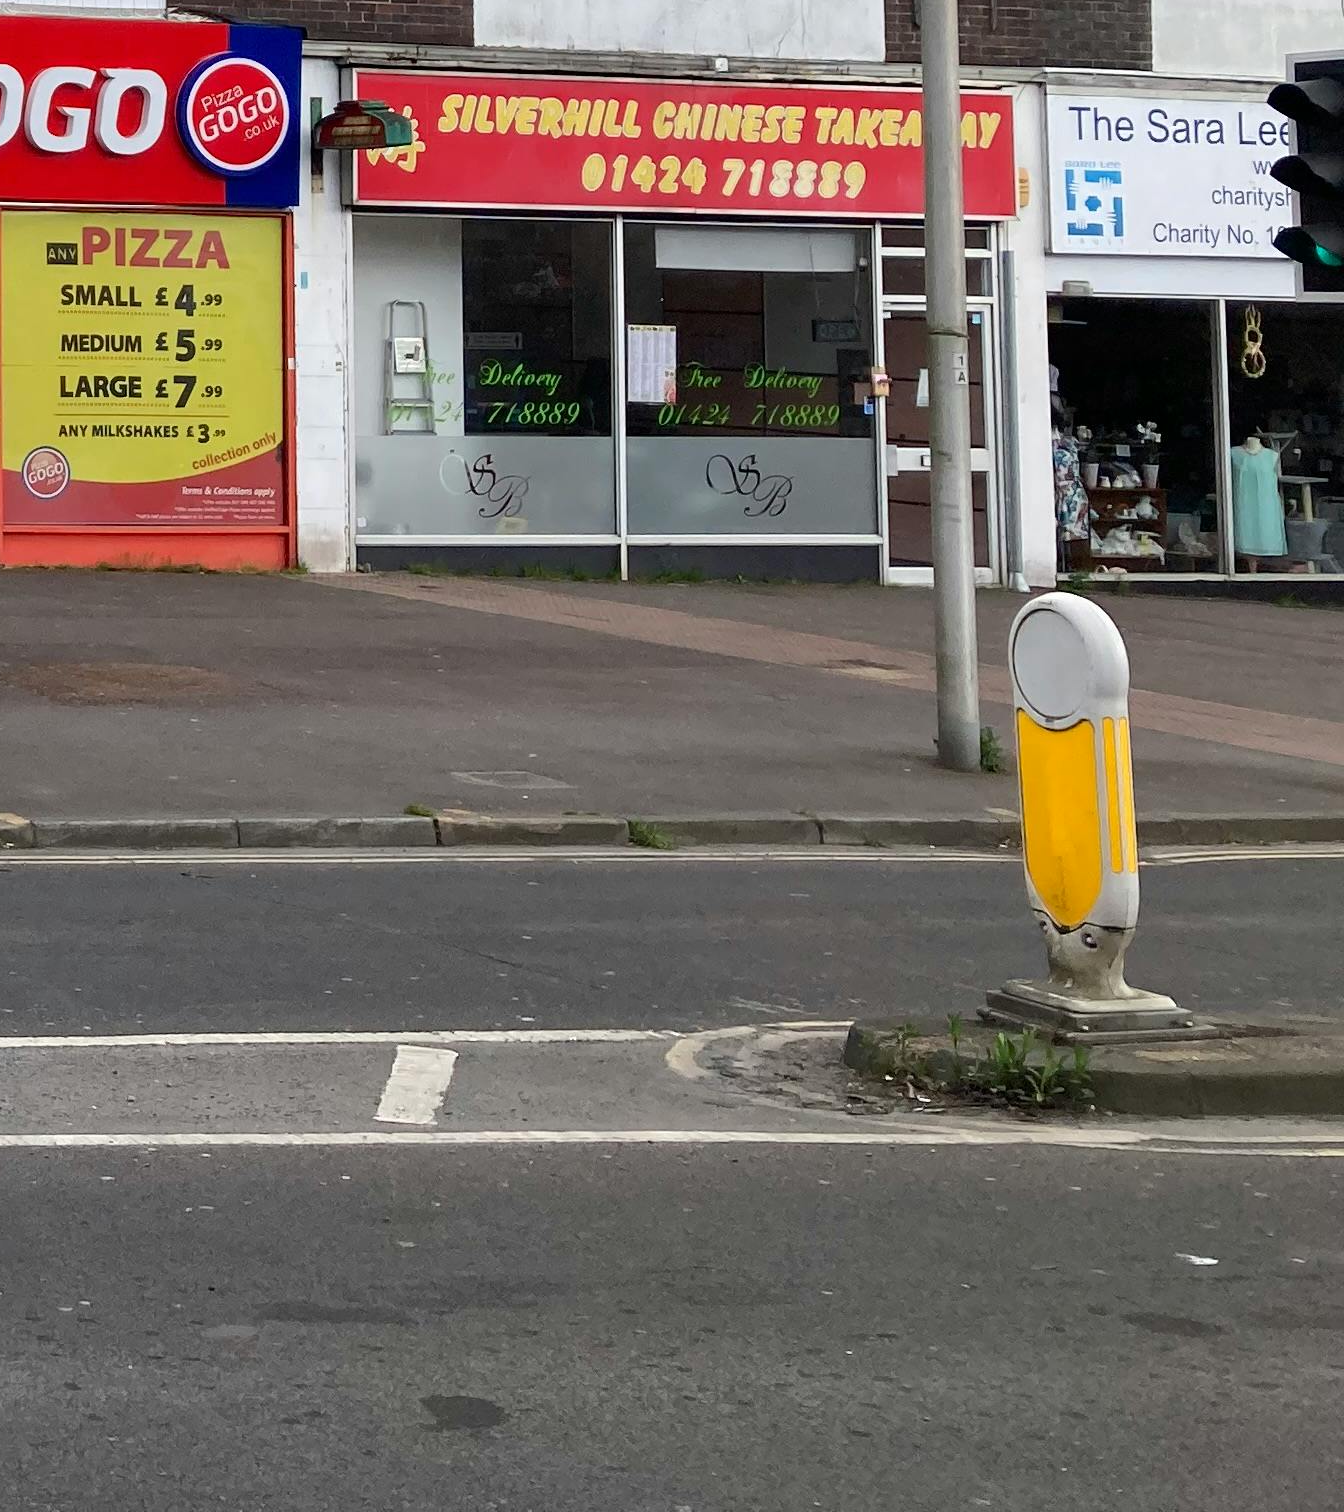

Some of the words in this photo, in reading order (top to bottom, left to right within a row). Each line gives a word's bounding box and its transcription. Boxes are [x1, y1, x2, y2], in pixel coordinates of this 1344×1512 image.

[201, 85, 244, 112] Pizza
[198, 86, 278, 142] GOGO
[437, 93, 642, 139] SILVERHILL
[652, 100, 806, 144] CHINESE
[814, 106, 1002, 149] TAKEAAY
[1068, 106, 1134, 142] The
[1147, 108, 1225, 145] Sara
[581, 152, 708, 195] 01424
[721, 158, 867, 199] 718889
[48, 246, 77, 262] ANY
[82, 227, 230, 269] PIZZA
[1153, 223, 1220, 248] Charity
[1228, 225, 1259, 246] No.
[60, 284, 142, 307] SMALL
[60, 334, 142, 352] MEDIUM
[957, 356, 964, 366] 1
[59, 375, 142, 398] LARGE
[479, 358, 563, 396] Delivery
[676, 360, 723, 388] Free
[743, 363, 824, 398] Delivery
[958, 371, 966, 382] A
[486, 401, 581, 425] 718889
[657, 404, 732, 426] 01424
[751, 404, 841, 426] 718889
[58, 425, 88, 437] ANY
[91, 425, 179, 438] MILKSHAKES
[192, 443, 250, 470] collection
[252, 430, 277, 451] only
[28, 462, 64, 484] GOGO
